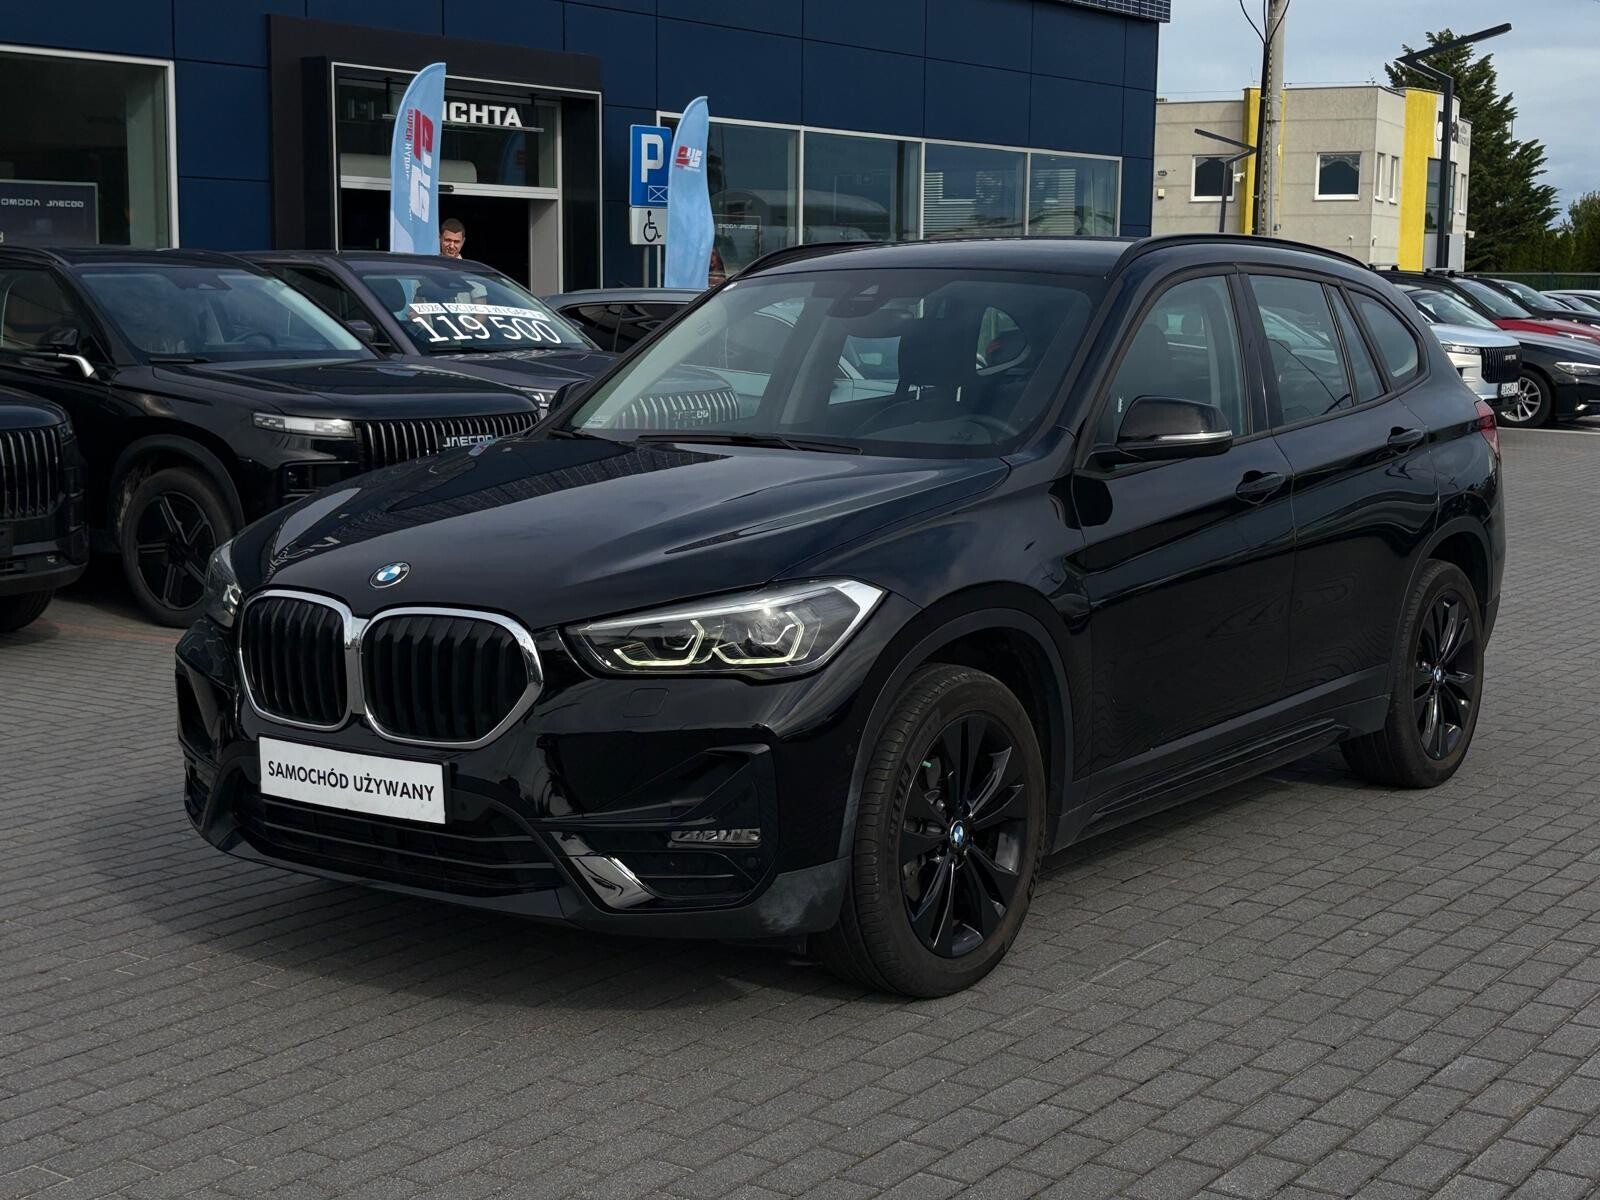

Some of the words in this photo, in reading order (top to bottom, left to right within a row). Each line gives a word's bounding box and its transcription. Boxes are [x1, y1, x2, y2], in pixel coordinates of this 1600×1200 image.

[442, 101, 522, 127] ICHTA
[641, 134, 664, 183] P
[1, 198, 40, 207] OMODA
[412, 315, 491, 343] 119
[488, 316, 561, 344] 500
[268, 760, 349, 789] SAMOCHÓD
[353, 772, 435, 801] UŻYWANY
